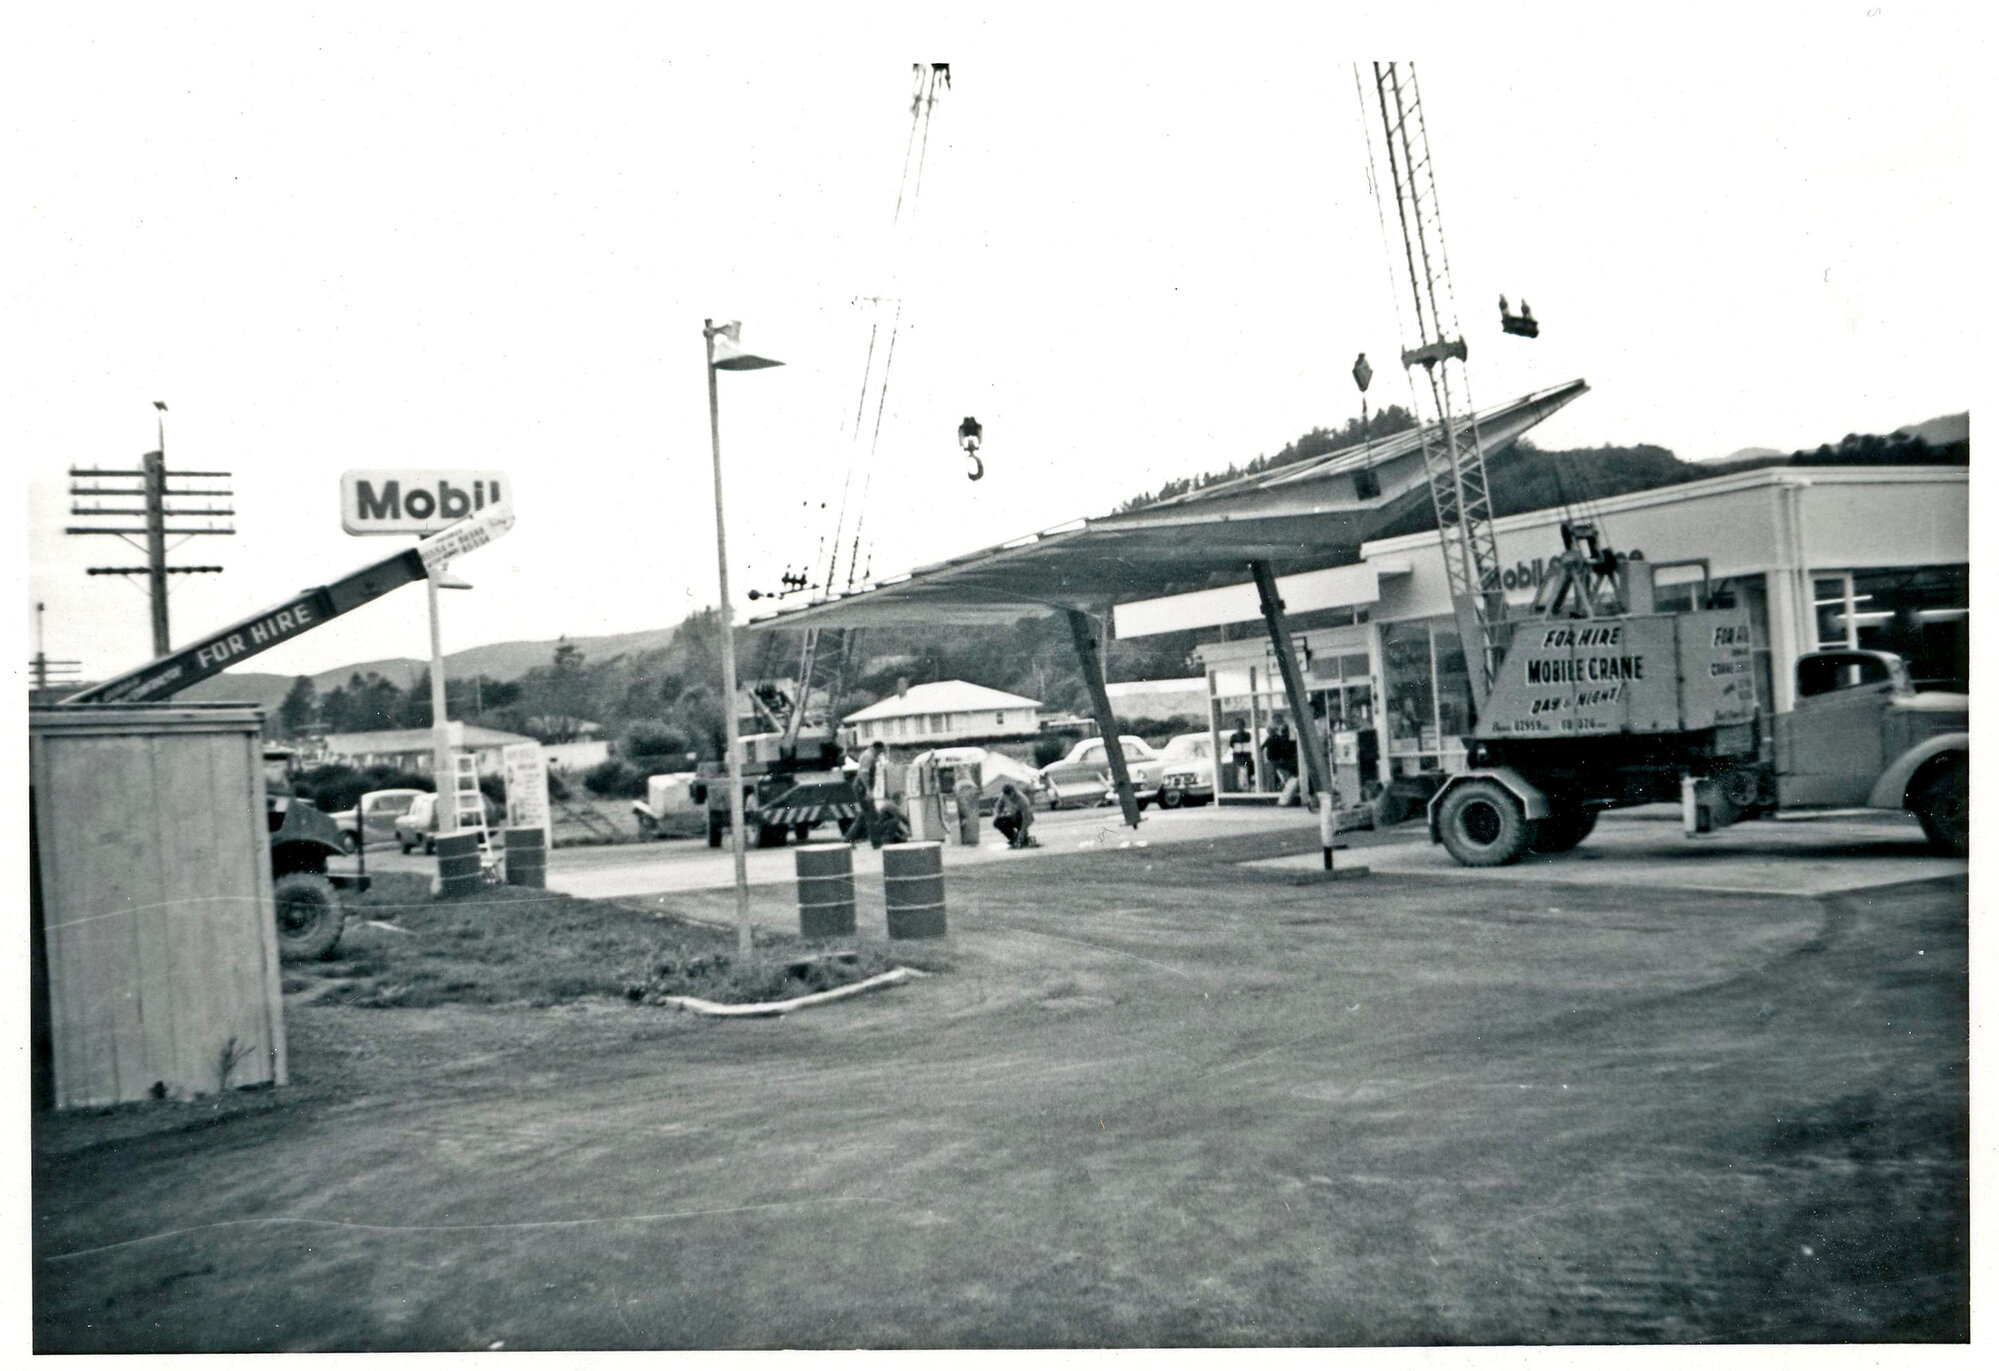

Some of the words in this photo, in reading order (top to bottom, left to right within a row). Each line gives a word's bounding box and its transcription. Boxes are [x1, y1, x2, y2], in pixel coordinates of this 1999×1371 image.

[356, 481, 501, 520] Mobil
[197, 636, 247, 669] FOR
[250, 603, 313, 645] HIRE
[1543, 628, 1575, 648] FOR
[1577, 627, 1621, 646] HIRE
[1527, 658, 1584, 684] MOBILE
[1588, 656, 1644, 681] CRANE
[1531, 696, 1561, 715] DAY
